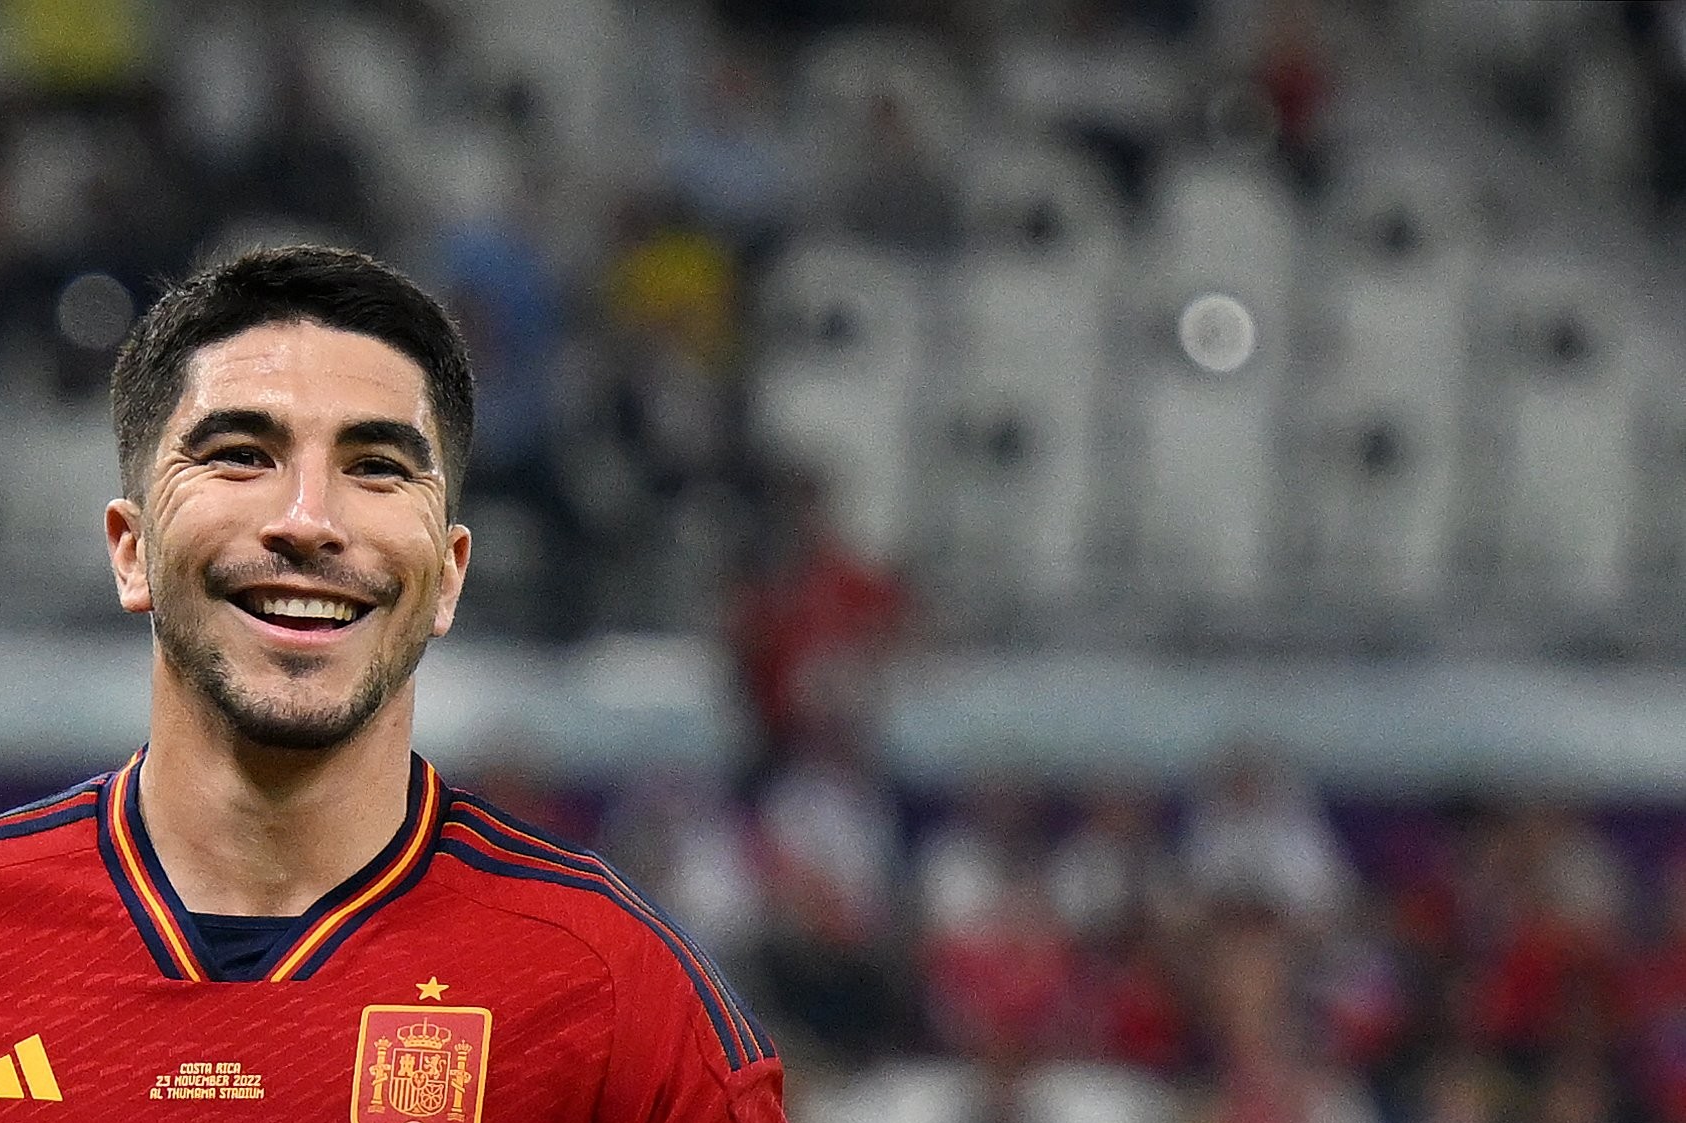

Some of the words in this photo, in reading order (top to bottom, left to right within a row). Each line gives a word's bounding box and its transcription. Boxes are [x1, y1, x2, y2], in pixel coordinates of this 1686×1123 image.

[180, 1062, 213, 1075] COSTA
[215, 1062, 241, 1075] RICA
[155, 1075, 171, 1087] 23
[174, 1075, 230, 1087] NOVEMBER
[233, 1074, 262, 1087] 2022
[149, 1087, 164, 1100] AL
[167, 1087, 216, 1100] THUMAMA
[219, 1087, 265, 1100] STADIUM
